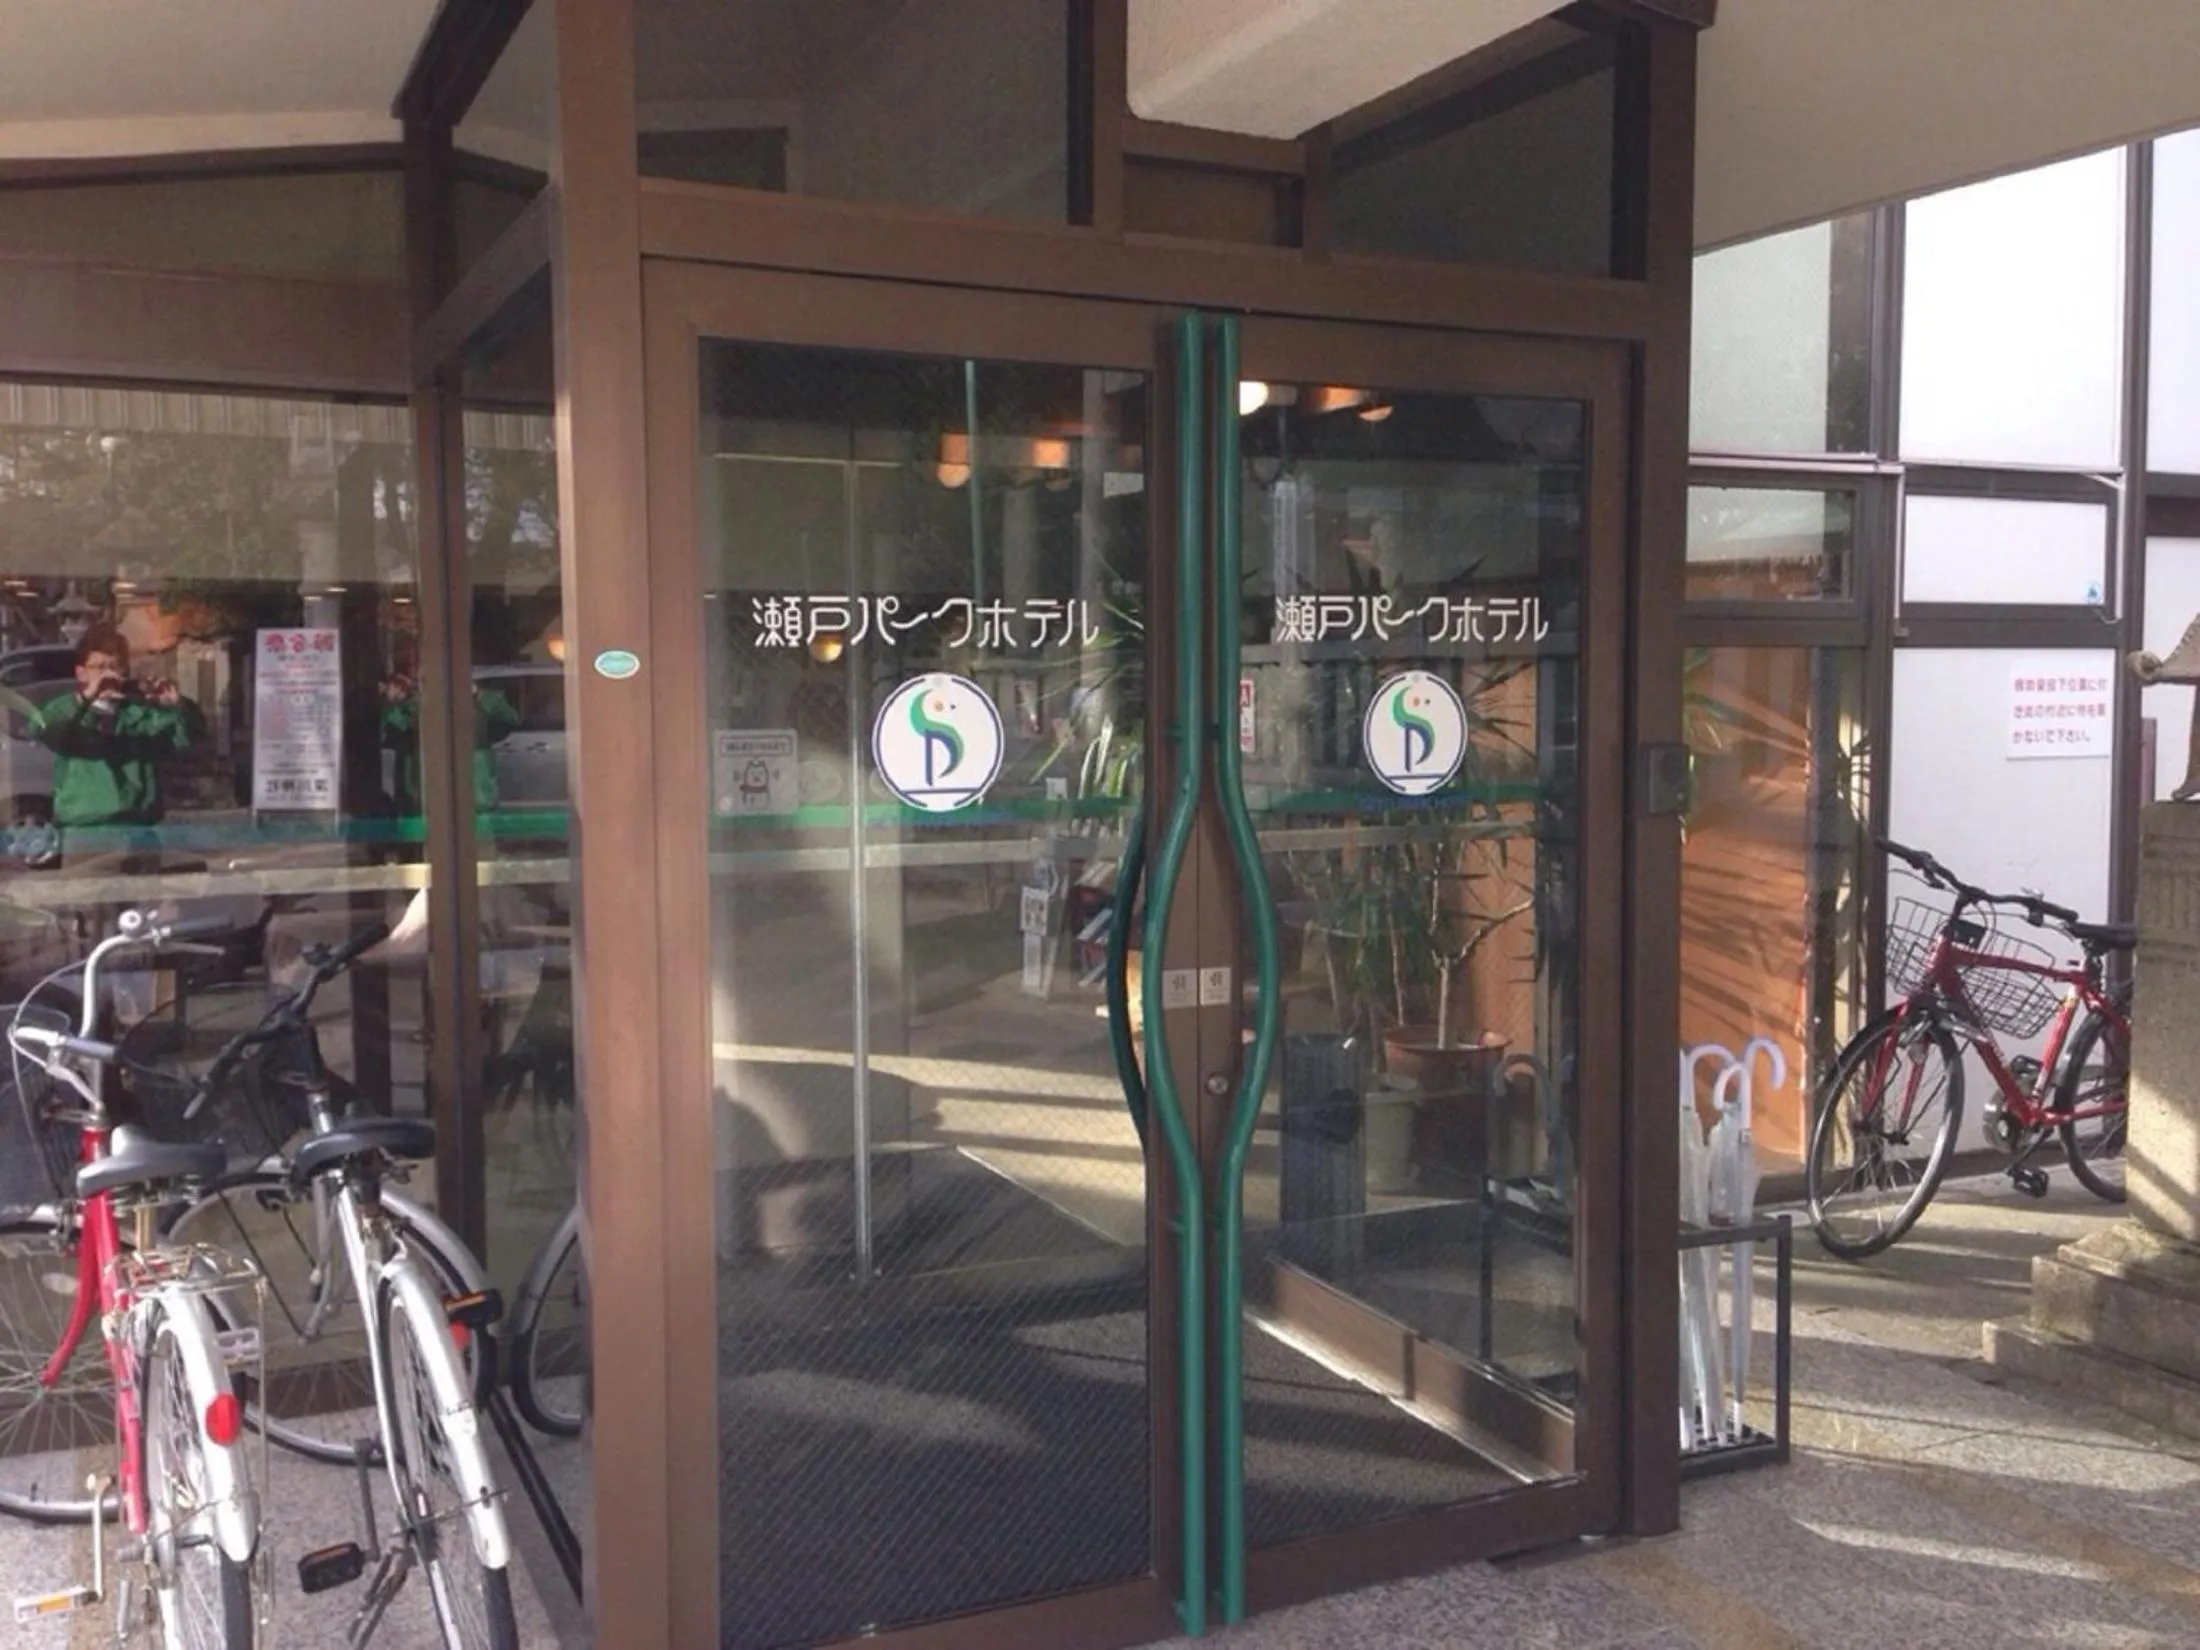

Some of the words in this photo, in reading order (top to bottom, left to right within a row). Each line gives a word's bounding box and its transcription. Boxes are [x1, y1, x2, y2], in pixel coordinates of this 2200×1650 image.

[751, 596, 1099, 648] 瀬戸パークホテル
[1275, 594, 1548, 642] 瀬戸パークホテル
